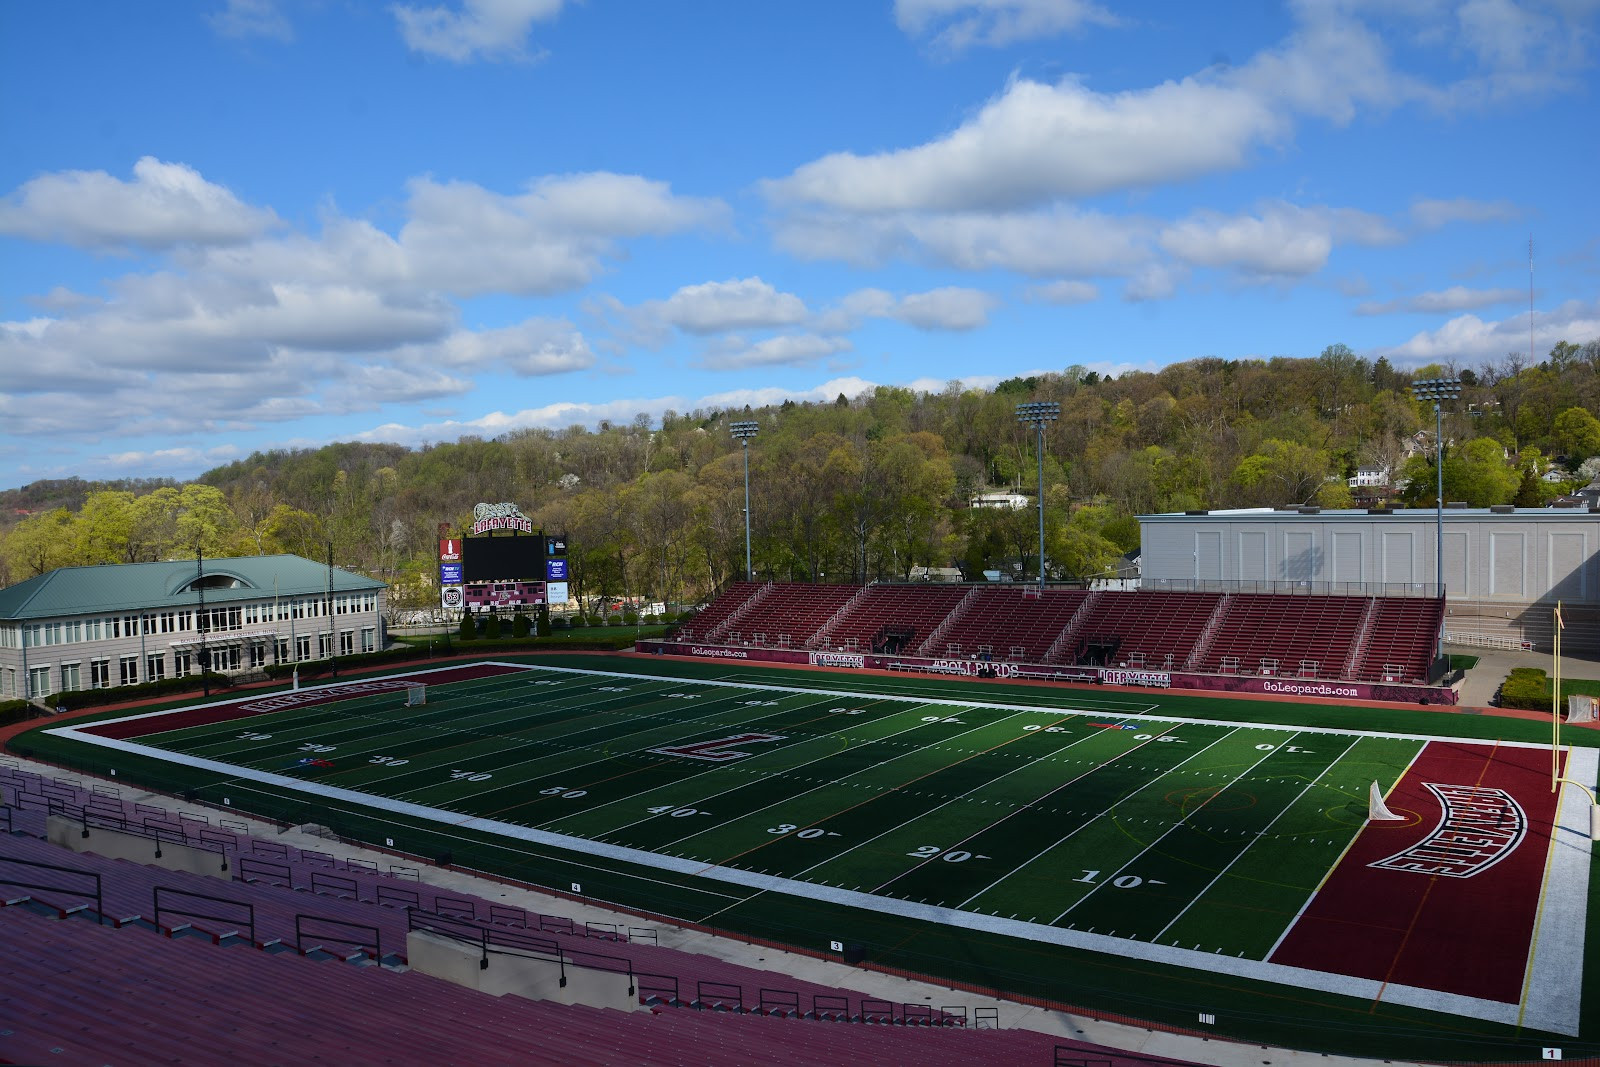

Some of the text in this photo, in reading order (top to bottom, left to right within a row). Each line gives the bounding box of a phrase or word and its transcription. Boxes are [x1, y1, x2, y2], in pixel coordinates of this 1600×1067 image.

[474, 517, 532, 535] LAFAYETTE
[691, 646, 748, 658] GoLeopards.com
[1263, 681, 1358, 696] GoLeopards.com
[538, 786, 588, 799] 50
[646, 805, 698, 818] 40
[766, 824, 824, 839] 30
[906, 846, 972, 862] 20
[1072, 870, 1142, 888] 10
